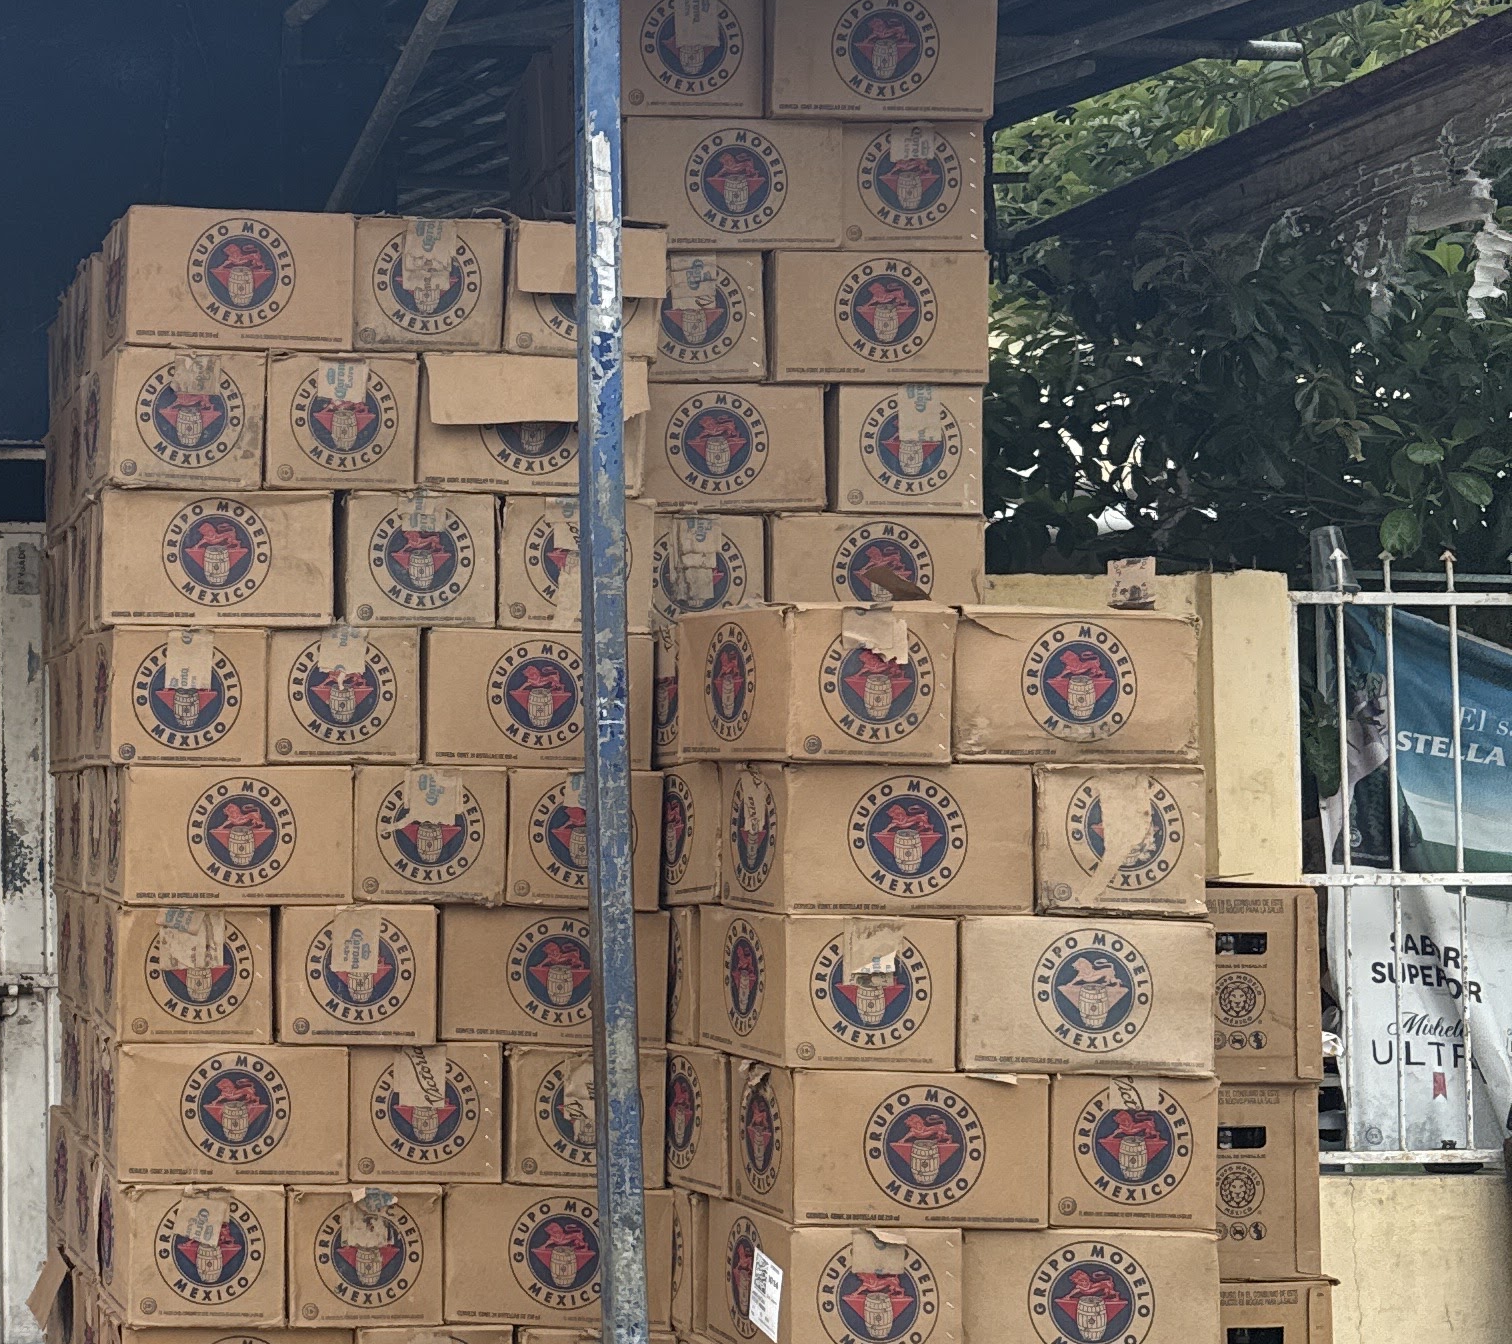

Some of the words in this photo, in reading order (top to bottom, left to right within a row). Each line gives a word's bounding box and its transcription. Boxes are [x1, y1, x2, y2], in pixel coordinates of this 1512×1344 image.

[835, 0, 874, 57] GRUPO
[848, 72, 922, 97] MEXICO
[689, 135, 723, 192] GRUPO
[735, 131, 784, 192] MODELO
[703, 206, 773, 230] MEXICO
[192, 225, 229, 283] GRUPO
[241, 221, 292, 286] MODELO
[838, 265, 873, 321] GRUPO
[885, 261, 934, 321] MODELO
[206, 301, 280, 325] MEXICO
[852, 336, 923, 360] MEXICO
[669, 398, 703, 455] GRUPO
[715, 393, 766, 452] MODELO
[153, 441, 228, 465] MEXICO
[309, 444, 383, 468] MEXICO
[684, 467, 755, 492] MEXICO
[166, 504, 203, 563] GRUPO
[216, 500, 268, 563] MODELO
[835, 529, 870, 585] GRUPO
[881, 525, 930, 584] MODELO
[181, 578, 256, 603] MEXICO
[388, 582, 460, 607] MEXICO
[1027, 630, 1064, 696] GRUPO
[1077, 625, 1134, 695] MODELO
[150, 722, 226, 747] MEXICO
[307, 716, 382, 741] MEXICO
[712, 710, 748, 736] MEXICO
[191, 785, 228, 844] GRUPO
[241, 780, 293, 844] MODELO
[853, 784, 892, 850] GRUPO
[906, 779, 964, 849] MODELO
[206, 859, 281, 884] MEXICO
[870, 866, 952, 894] MEXICO
[351, 928, 363, 969] Corona
[1038, 936, 1078, 1003] GRUPO
[1092, 932, 1150, 1005] MODELO
[1235, 975, 1262, 996] MODELO
[325, 996, 400, 1021] MEXICO
[1054, 1022, 1137, 1049] MEXICO
[185, 1059, 222, 1120] GRUPO
[235, 1055, 287, 1120] MODELO
[869, 1093, 910, 1159] GRUPO
[924, 1088, 982, 1161] MODELO
[199, 1135, 275, 1161] MEXICO
[390, 1136, 466, 1161] MEXICO
[1094, 1174, 1176, 1201] MEXICO
[1235, 1165, 1261, 1187] MODELO
[885, 1178, 968, 1205] MEXICO
[1033, 1249, 1076, 1315] GRUPO
[1090, 1245, 1151, 1318] MODELO
